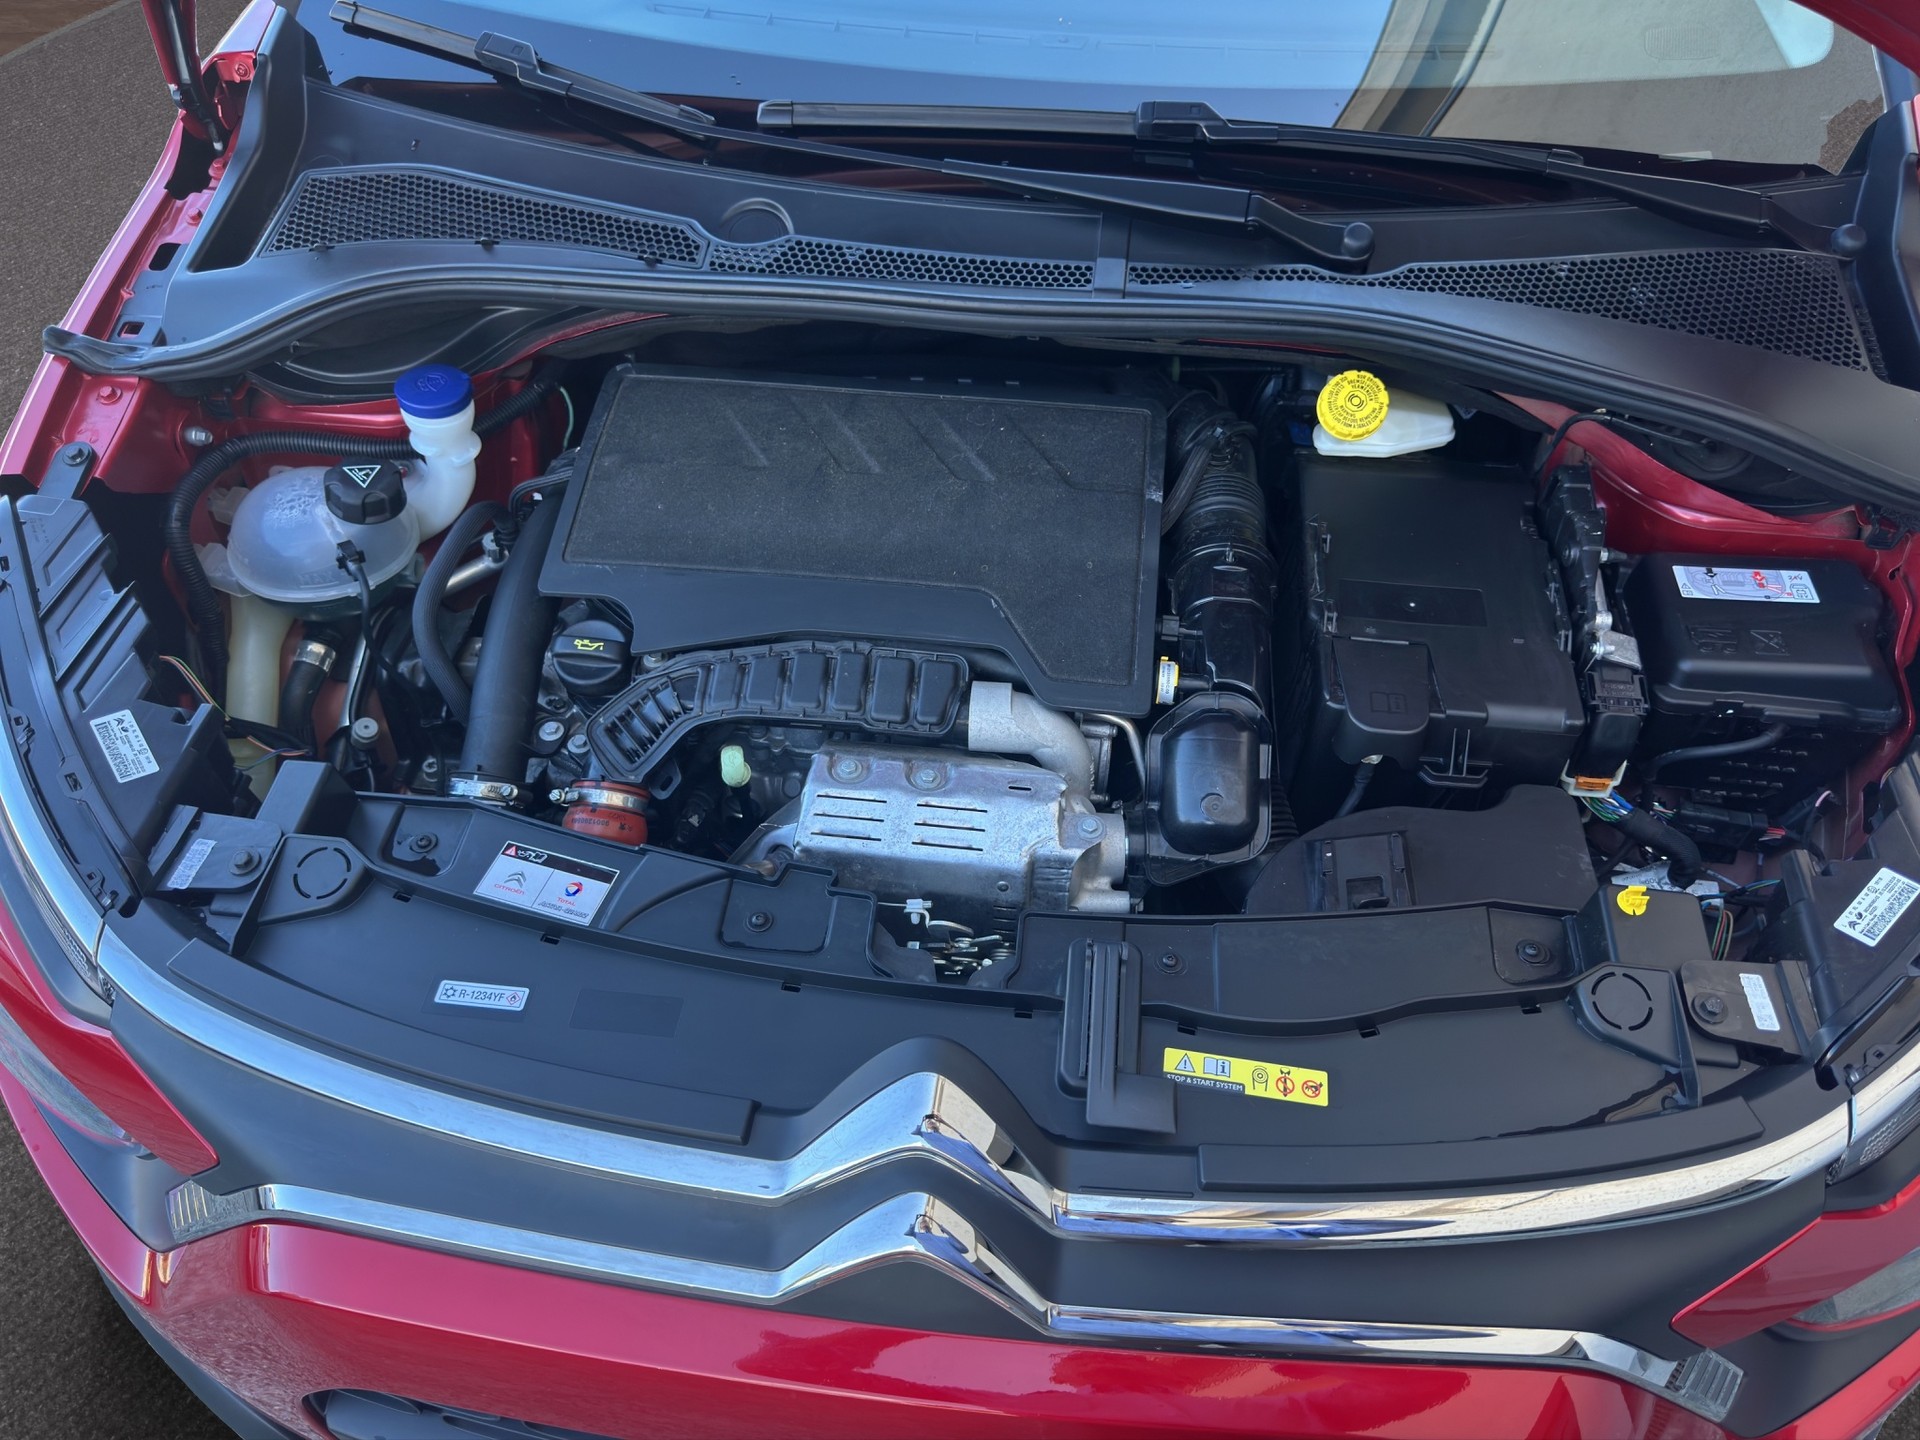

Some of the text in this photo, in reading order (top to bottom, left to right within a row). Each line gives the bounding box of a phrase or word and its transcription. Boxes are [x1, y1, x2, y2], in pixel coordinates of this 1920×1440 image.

[557, 897, 576, 906] TOTAL
[459, 989, 506, 1002] R-1234YF
[1192, 1077, 1215, 1087] START
[1216, 1081, 1243, 1091] SYSTEM
